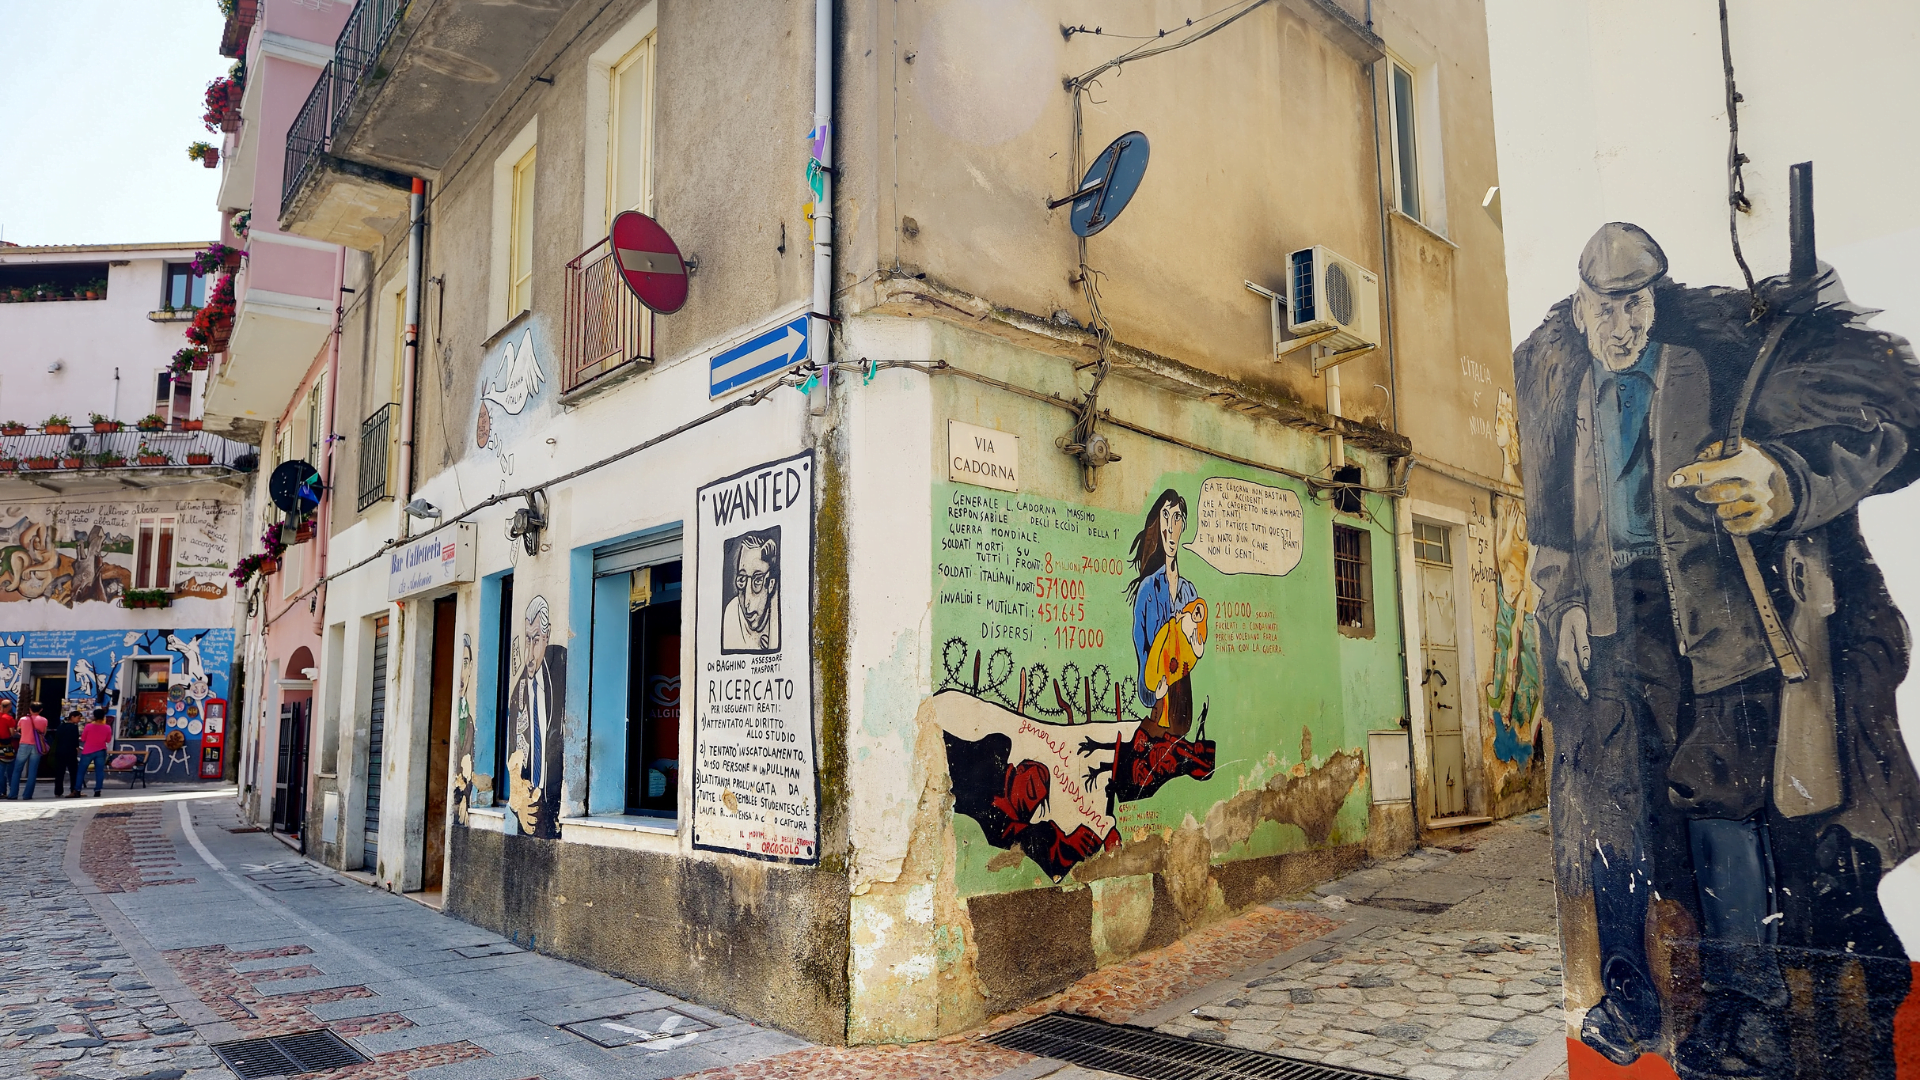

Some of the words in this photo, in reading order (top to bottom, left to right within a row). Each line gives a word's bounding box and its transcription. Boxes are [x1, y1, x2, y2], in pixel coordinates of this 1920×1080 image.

[975, 437, 995, 454] VIA
[954, 456, 1015, 481] CADORNA
[1205, 484, 1208, 492] E
[1210, 483, 1213, 491] A
[1216, 483, 1223, 491] TE
[713, 467, 801, 526] WANTED
[66, 505, 95, 518] quando
[132, 503, 159, 515] albero
[953, 490, 999, 509] GENERALE
[1017, 501, 1056, 515] CADORNA
[1067, 508, 1095, 522] MASSIMO
[71, 516, 89, 524] stato
[949, 523, 982, 535] GUERRA
[1088, 528, 1109, 539] DELLA
[1200, 534, 1203, 542] E
[942, 538, 972, 551] SOLDATI
[977, 542, 1004, 551] MORTI
[1017, 547, 1030, 556] SU
[1208, 546, 1220, 555] NON
[180, 551, 190, 562] che
[194, 555, 209, 563] non
[391, 554, 403, 574] Bar
[406, 537, 441, 568] Caffetteria
[976, 552, 1001, 563] TUTTI
[1045, 552, 1053, 574] 8
[938, 563, 972, 578] SOLDATI
[979, 566, 1015, 585] ITALIANI
[1016, 581, 1035, 594] MORTI
[190, 583, 222, 595] denaro
[940, 589, 972, 604] INVALIDI
[977, 594, 981, 604] E
[1253, 644, 1259, 652] LA
[717, 660, 746, 672] BAGHINO
[751, 654, 783, 665] ASSESSORE
[751, 664, 780, 674] TRASPORTI
[709, 678, 794, 703] RICERCATO
[711, 704, 720, 714] PER
[745, 718, 753, 728] AL
[755, 718, 783, 729] DIRITTO
[747, 730, 763, 739] ALLO
[765, 730, 796, 743] STUDIO
[1019, 719, 1072, 767] generali
[709, 746, 737, 757] TENTATO
[710, 760, 719, 770] 150
[723, 760, 750, 772] PERSONE
[766, 763, 800, 779] PULLMAN
[699, 790, 715, 802] TUTTE
[789, 783, 799, 796] DA
[1054, 765, 1110, 835] assassini
[699, 805, 716, 816] LAUTA
[780, 817, 807, 830] CATTURA
[762, 842, 800, 855] ORGOSOLO
